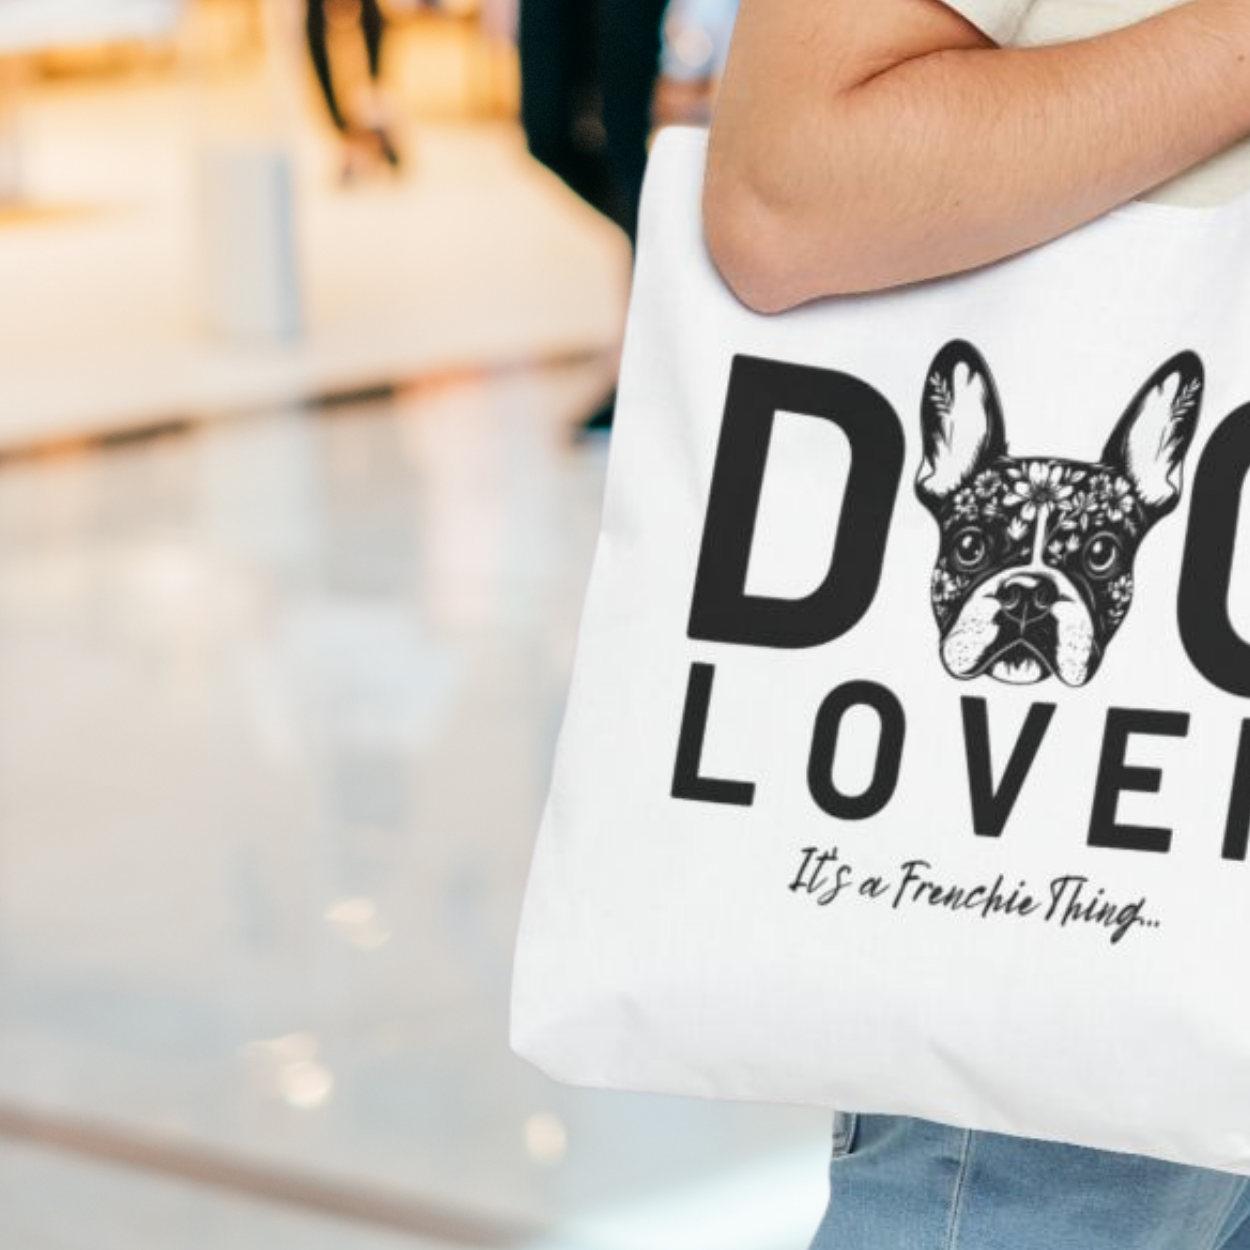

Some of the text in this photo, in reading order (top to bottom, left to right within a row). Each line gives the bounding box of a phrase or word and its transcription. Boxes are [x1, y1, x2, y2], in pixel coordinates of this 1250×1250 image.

[788, 846, 1161, 944] It's a Frenchie Thing...
